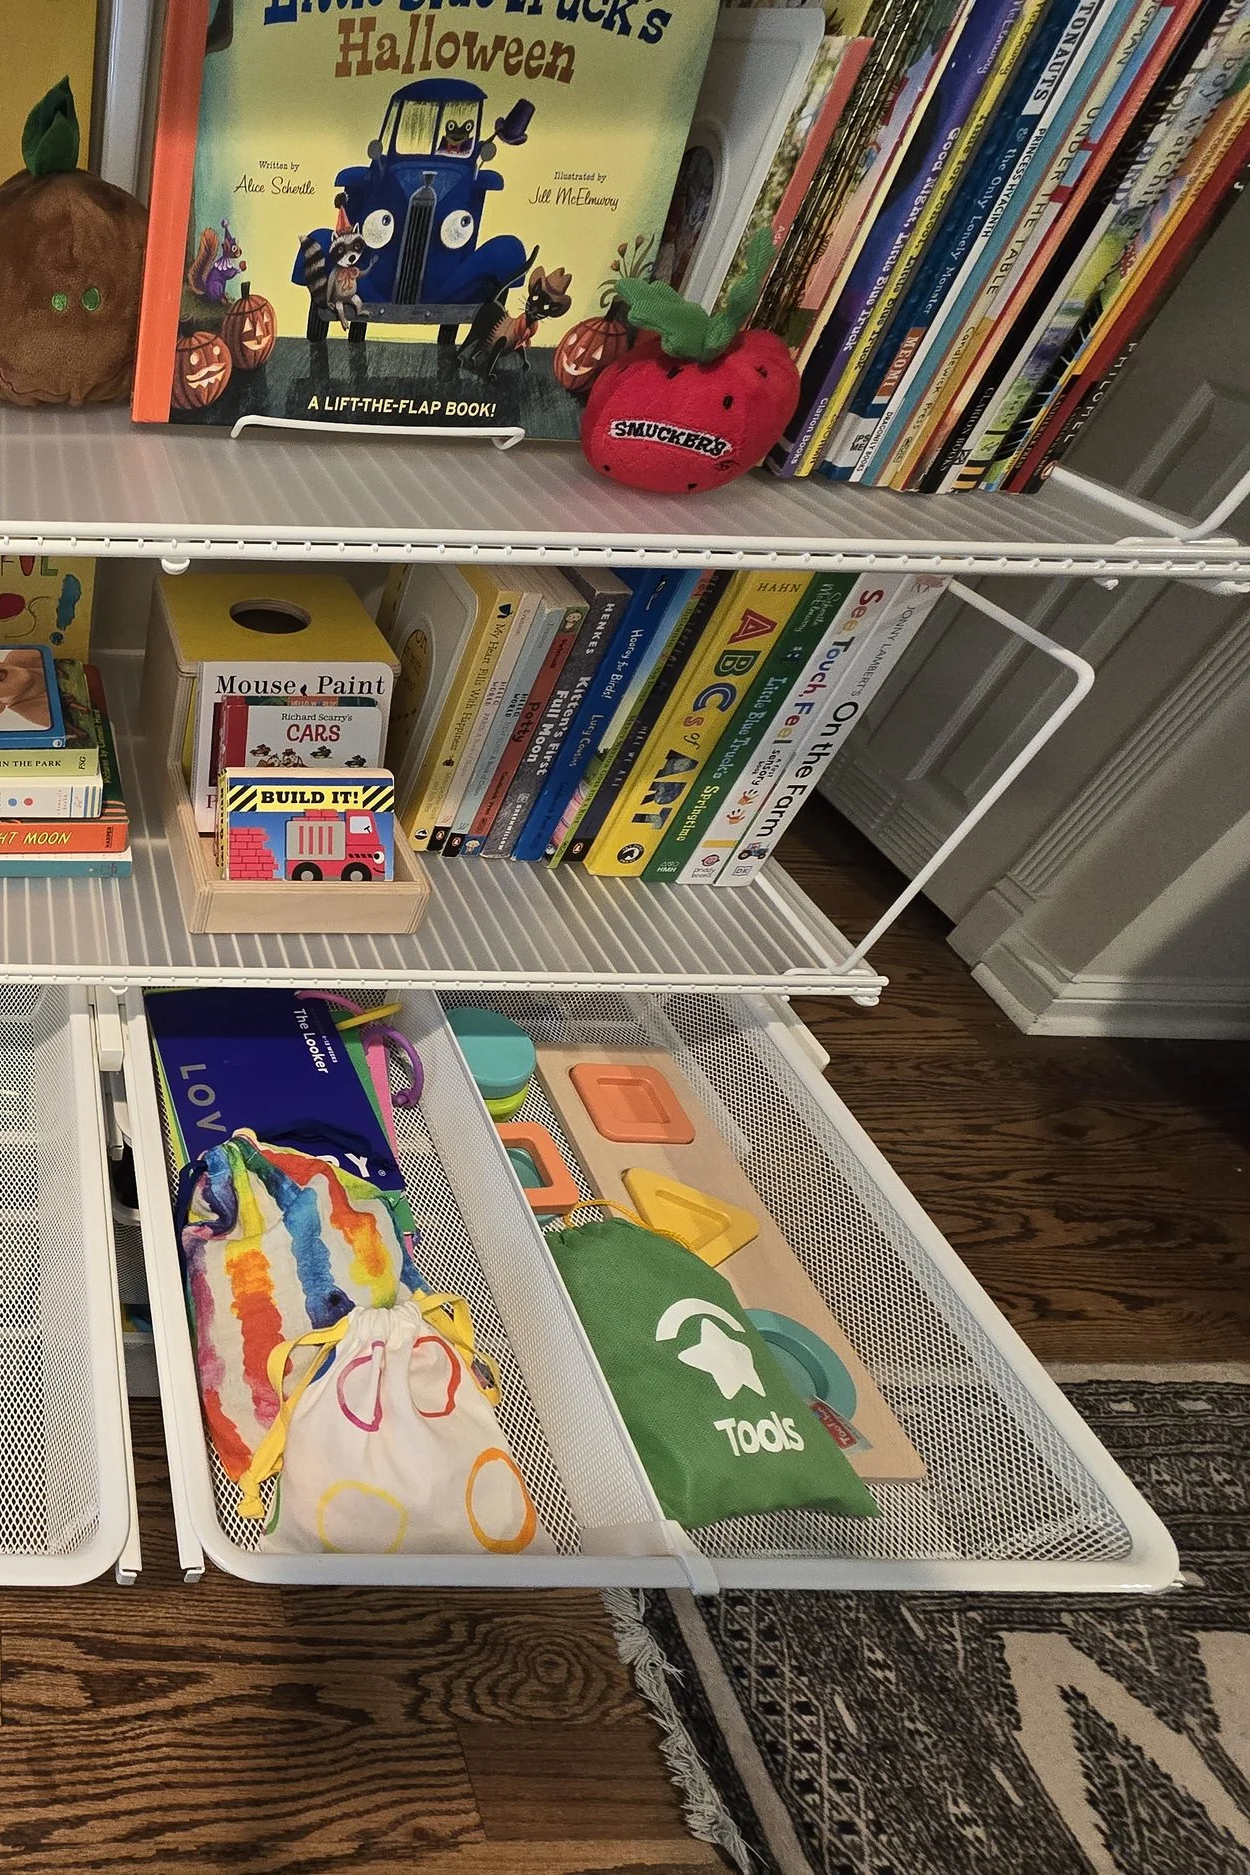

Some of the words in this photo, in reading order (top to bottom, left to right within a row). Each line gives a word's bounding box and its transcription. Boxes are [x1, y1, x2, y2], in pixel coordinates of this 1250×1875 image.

[333, 14, 577, 85] Halloween
[1011, 127, 1046, 182] PRINCESS
[1049, 105, 1103, 183] UNDER
[233, 174, 267, 196] Alice
[270, 175, 316, 197] Schertle
[528, 186, 553, 207] Jill
[554, 187, 620, 211] McElmurry
[981, 182, 1017, 238] HYACINTH
[1022, 191, 1052, 229] THE
[985, 237, 1026, 297] TABLE
[888, 336, 918, 387] MEOMI
[932, 325, 976, 395] Candlewick
[307, 395, 320, 412] A
[322, 396, 443, 415] LIFT-THE-FLAP
[444, 397, 497, 419] BOOK!
[912, 401, 934, 431] Press
[755, 582, 803, 594] HAHN
[585, 602, 617, 656] HENKES
[837, 588, 886, 636] See
[889, 605, 917, 642] JONNY
[215, 674, 296, 696] Mouse
[317, 674, 387, 696] Paint
[797, 636, 856, 698] Touch,
[850, 641, 893, 698] LAMBERT'S
[281, 712, 317, 722] Richard
[317, 713, 354, 724] Scarry's
[545, 689, 571, 721] Full
[553, 674, 592, 741] Kitten's
[772, 701, 815, 746] Feel
[819, 701, 861, 739] On
[286, 723, 342, 743] CARS
[525, 721, 556, 764] Moon
[12, 759, 32, 769] THE
[34, 759, 63, 769] PARK
[77, 755, 88, 771] FSG
[535, 740, 561, 777] First
[793, 741, 835, 780] the
[260, 790, 326, 805] BUILD
[331, 790, 360, 805] IT!
[755, 783, 809, 839] Farm
[22, 831, 73, 847] MOON
[293, 1008, 310, 1031] The
[303, 1032, 330, 1075] Looker
[713, 1410, 805, 1458] Tools
